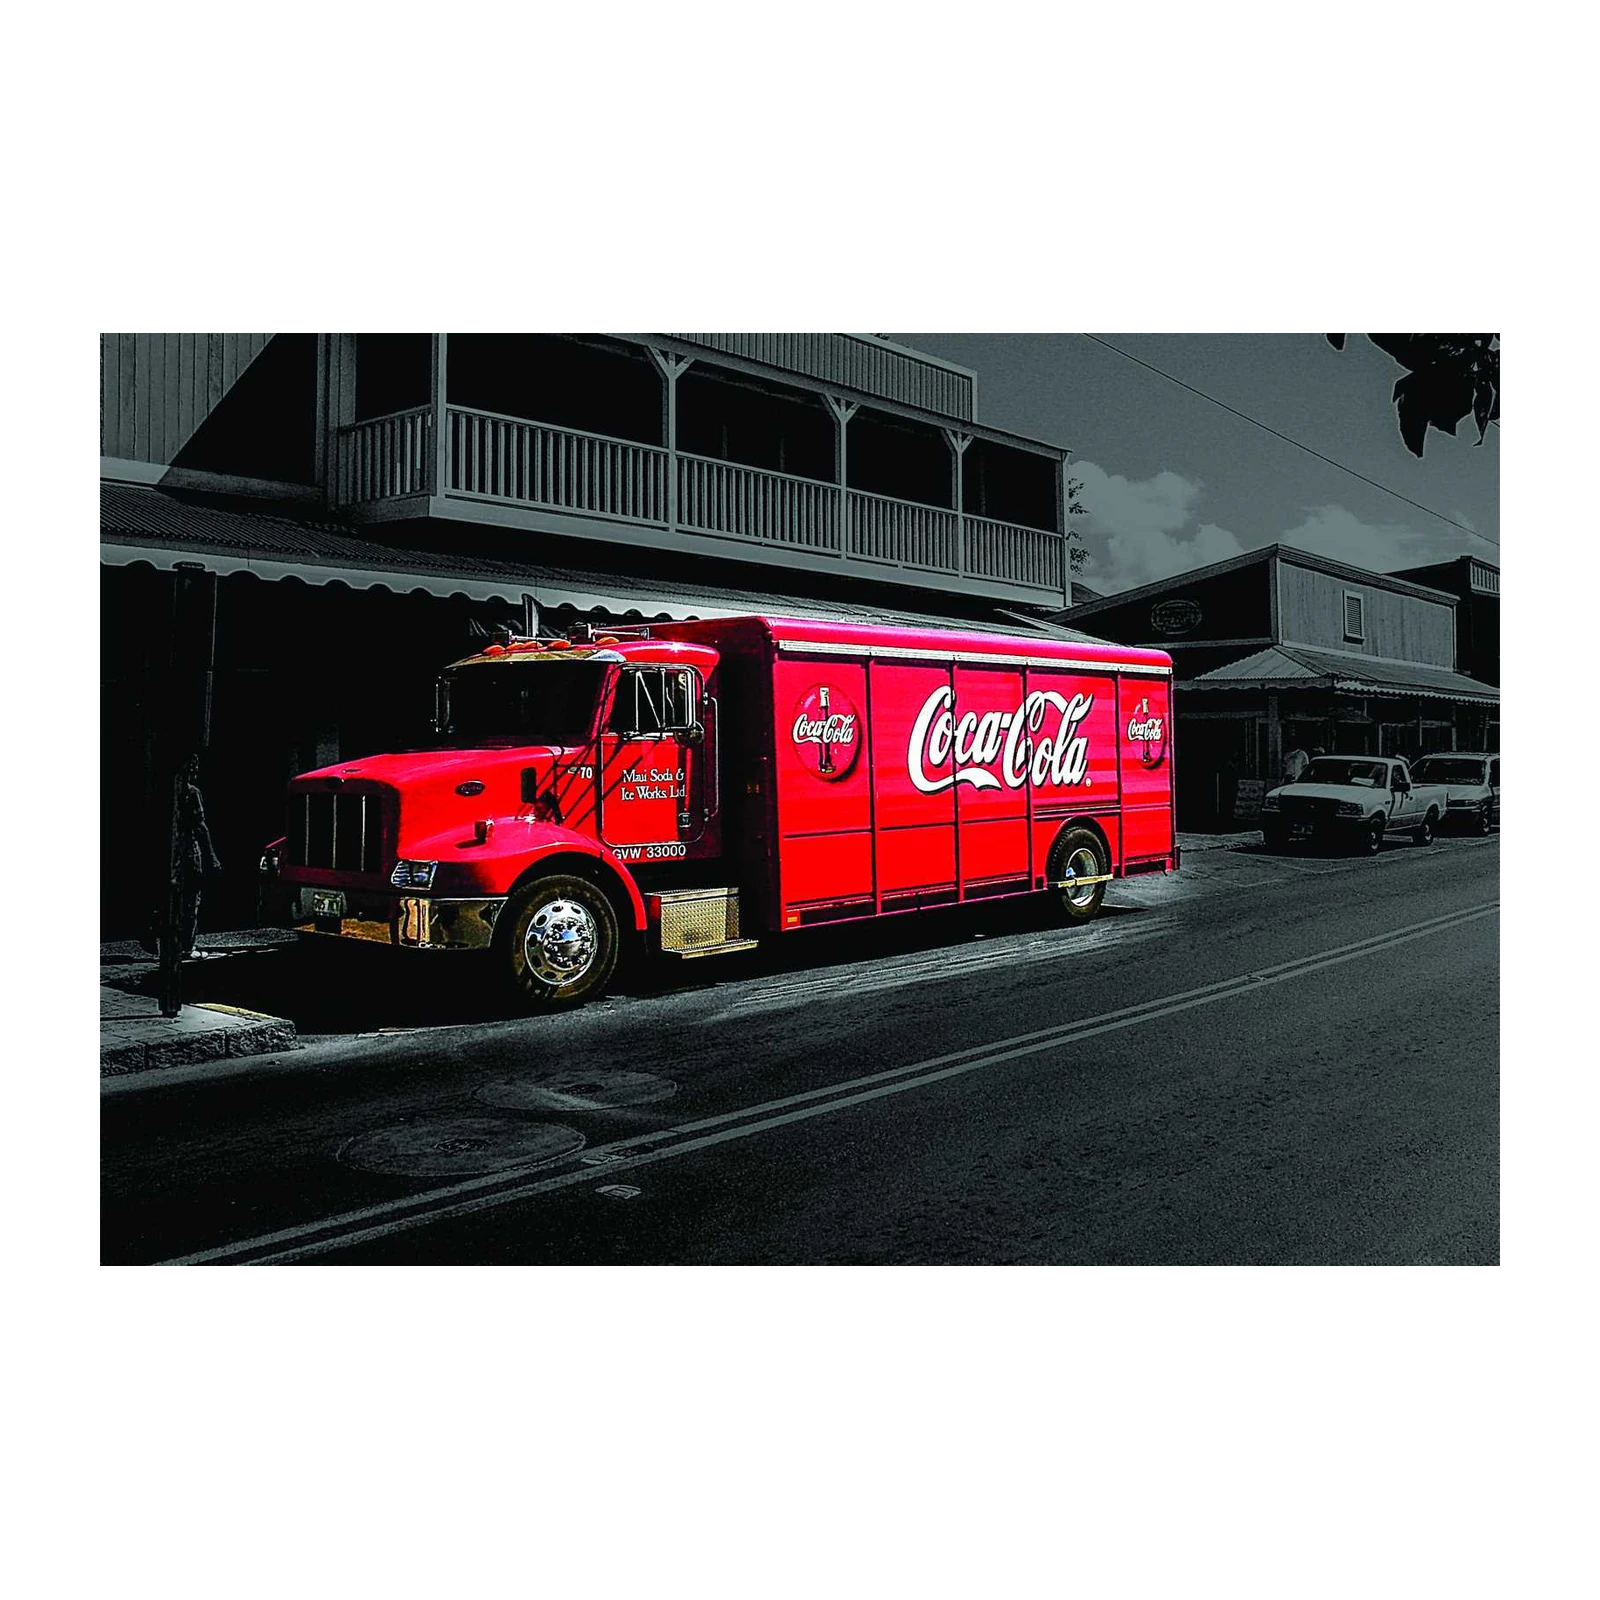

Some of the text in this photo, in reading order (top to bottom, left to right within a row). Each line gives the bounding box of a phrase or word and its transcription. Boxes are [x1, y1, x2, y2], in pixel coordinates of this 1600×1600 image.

[793, 713, 855, 744] Coca-Cola
[907, 686, 1093, 792] Coca-Cola
[580, 766, 593, 779] 70
[622, 768, 685, 783] Maui Soda &
[621, 787, 635, 801] Ice
[612, 845, 687, 860] GVW 33000
